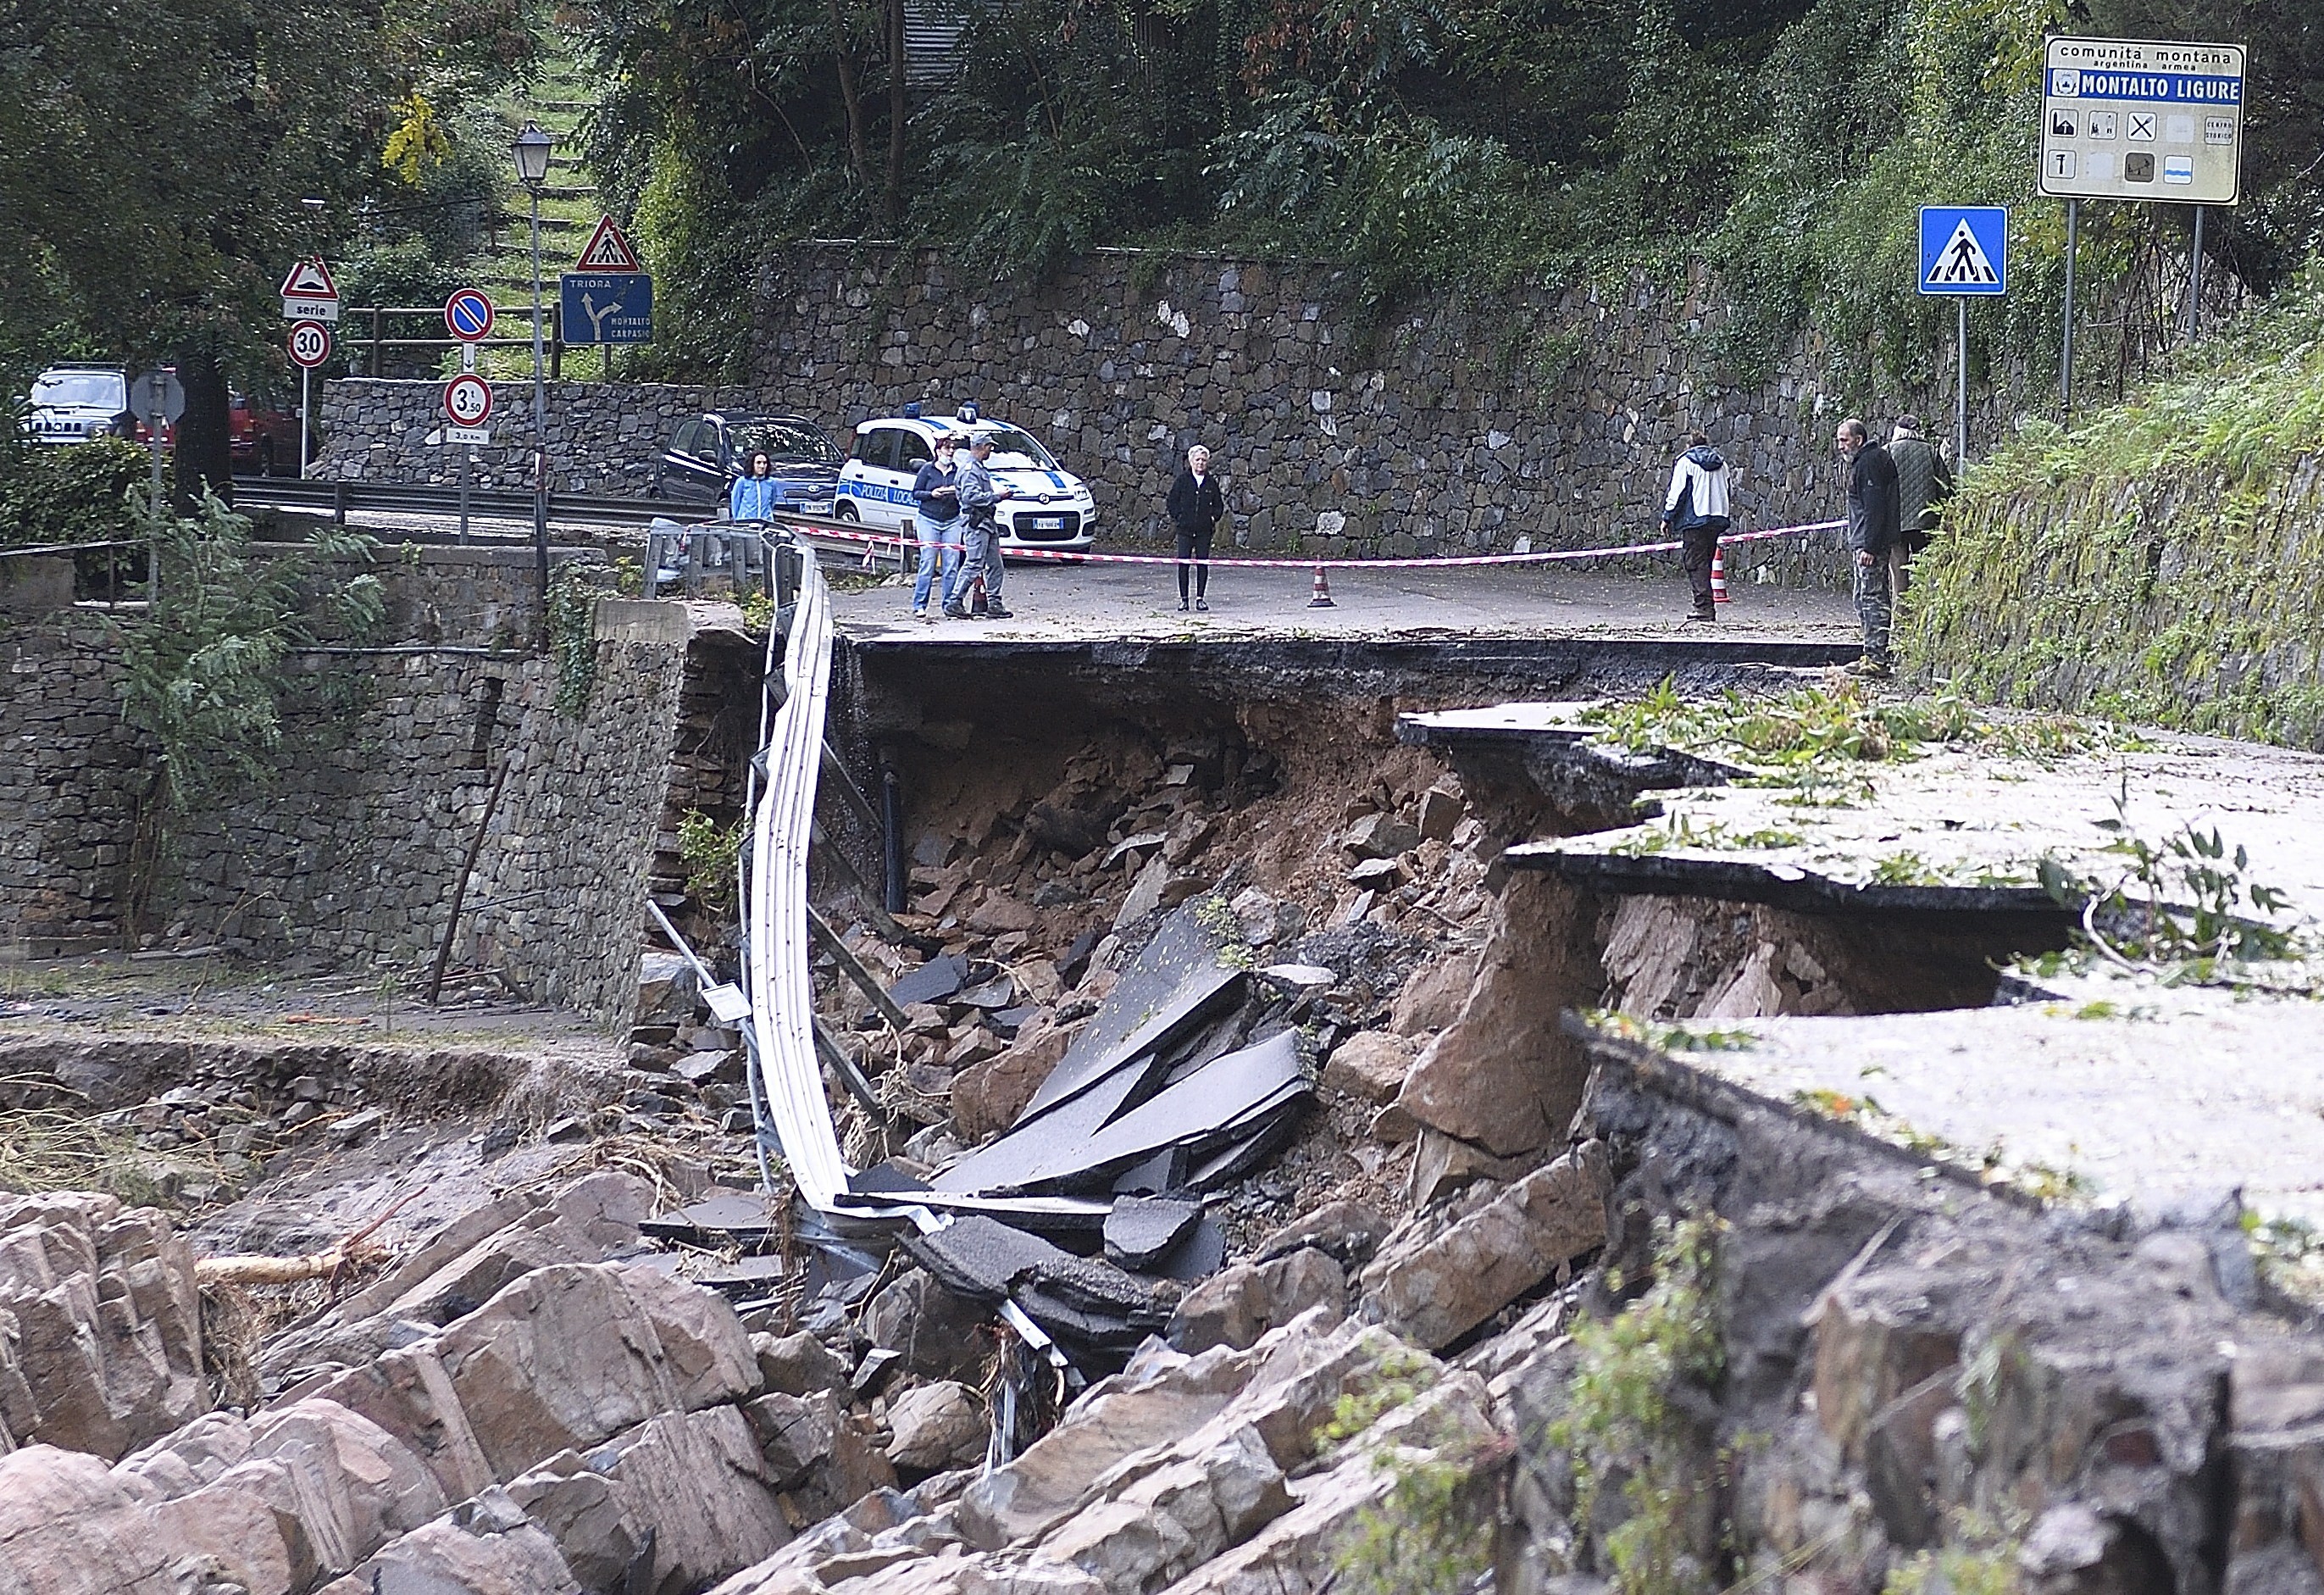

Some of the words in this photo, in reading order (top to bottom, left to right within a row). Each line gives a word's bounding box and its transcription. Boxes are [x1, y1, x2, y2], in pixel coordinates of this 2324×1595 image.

[2156, 51, 2231, 64] montana
[2094, 60, 2149, 69] argentina
[2082, 75, 2168, 97] MONTALTO
[2177, 79, 2240, 100] LIGURE
[569, 280, 612, 288] TRIORA
[297, 304, 326, 316] serie
[297, 331, 321, 353] 30
[861, 484, 888, 501] POLIZIA
